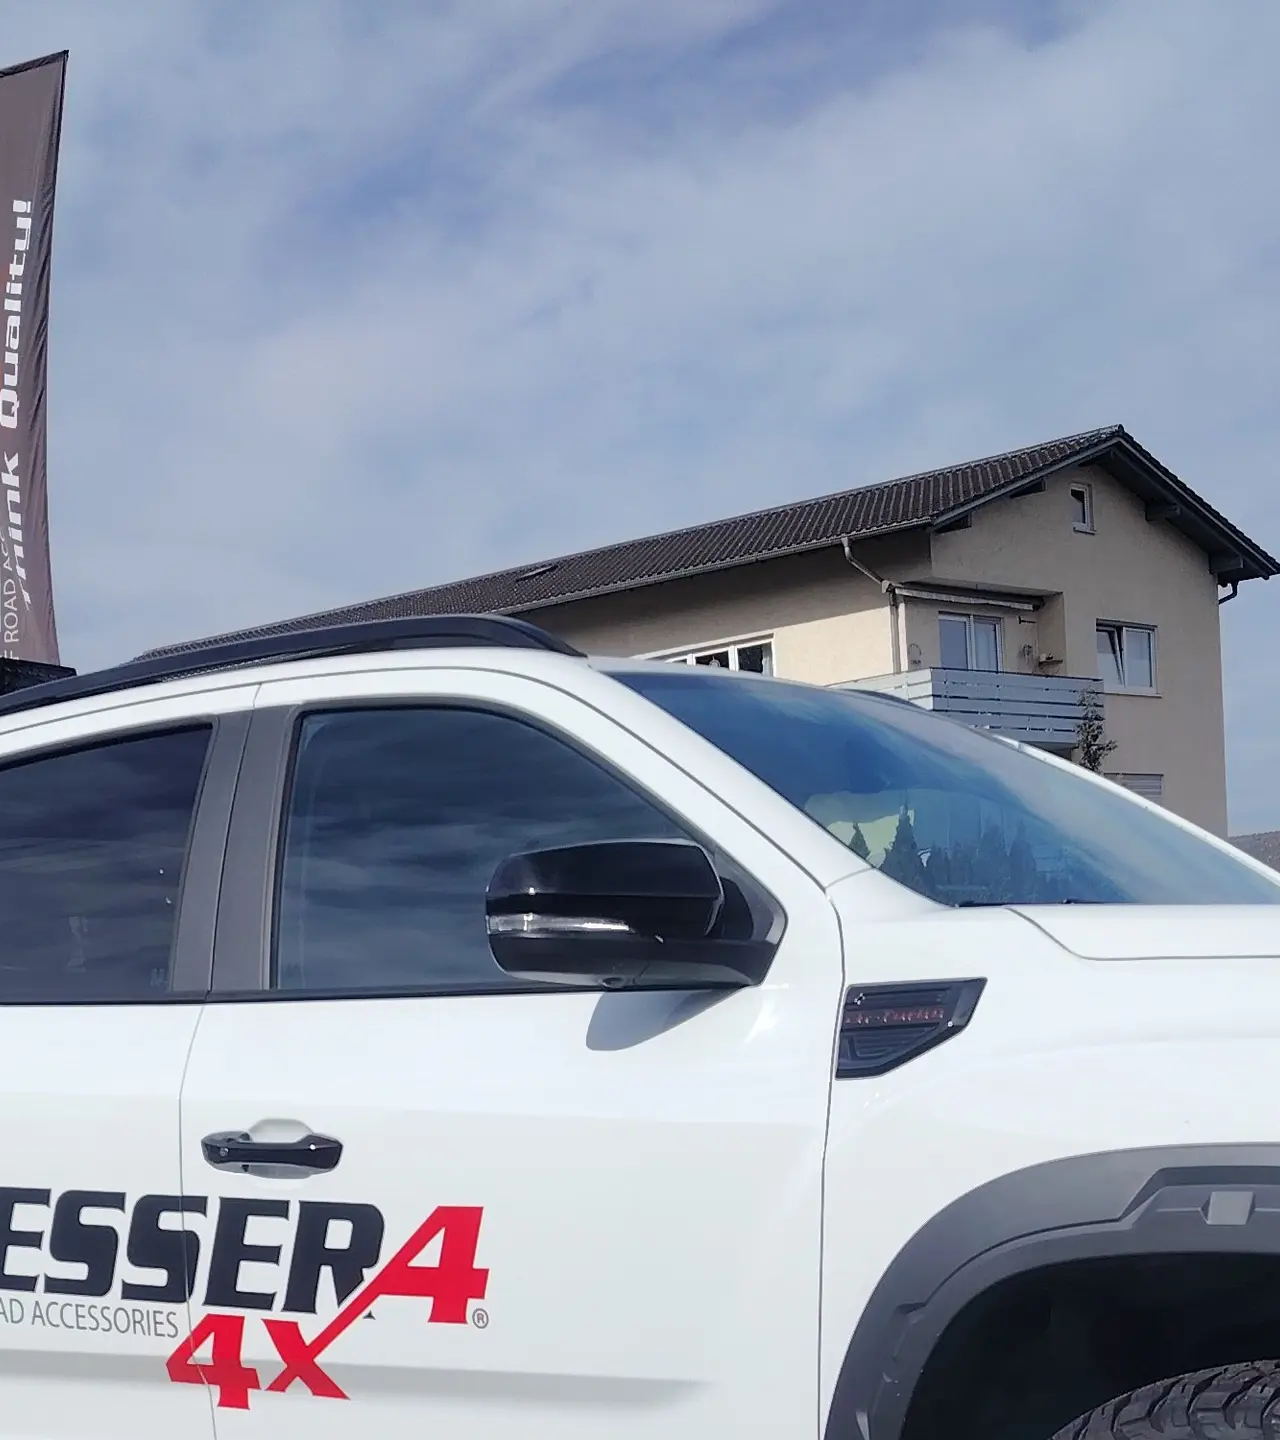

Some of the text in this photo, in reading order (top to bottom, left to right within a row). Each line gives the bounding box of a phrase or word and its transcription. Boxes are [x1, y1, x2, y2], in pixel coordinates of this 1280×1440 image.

[0, 199, 32, 429] Quality!
[4, 579, 20, 644] ROAD
[31, 1299, 180, 1339] ACCESSORIES
